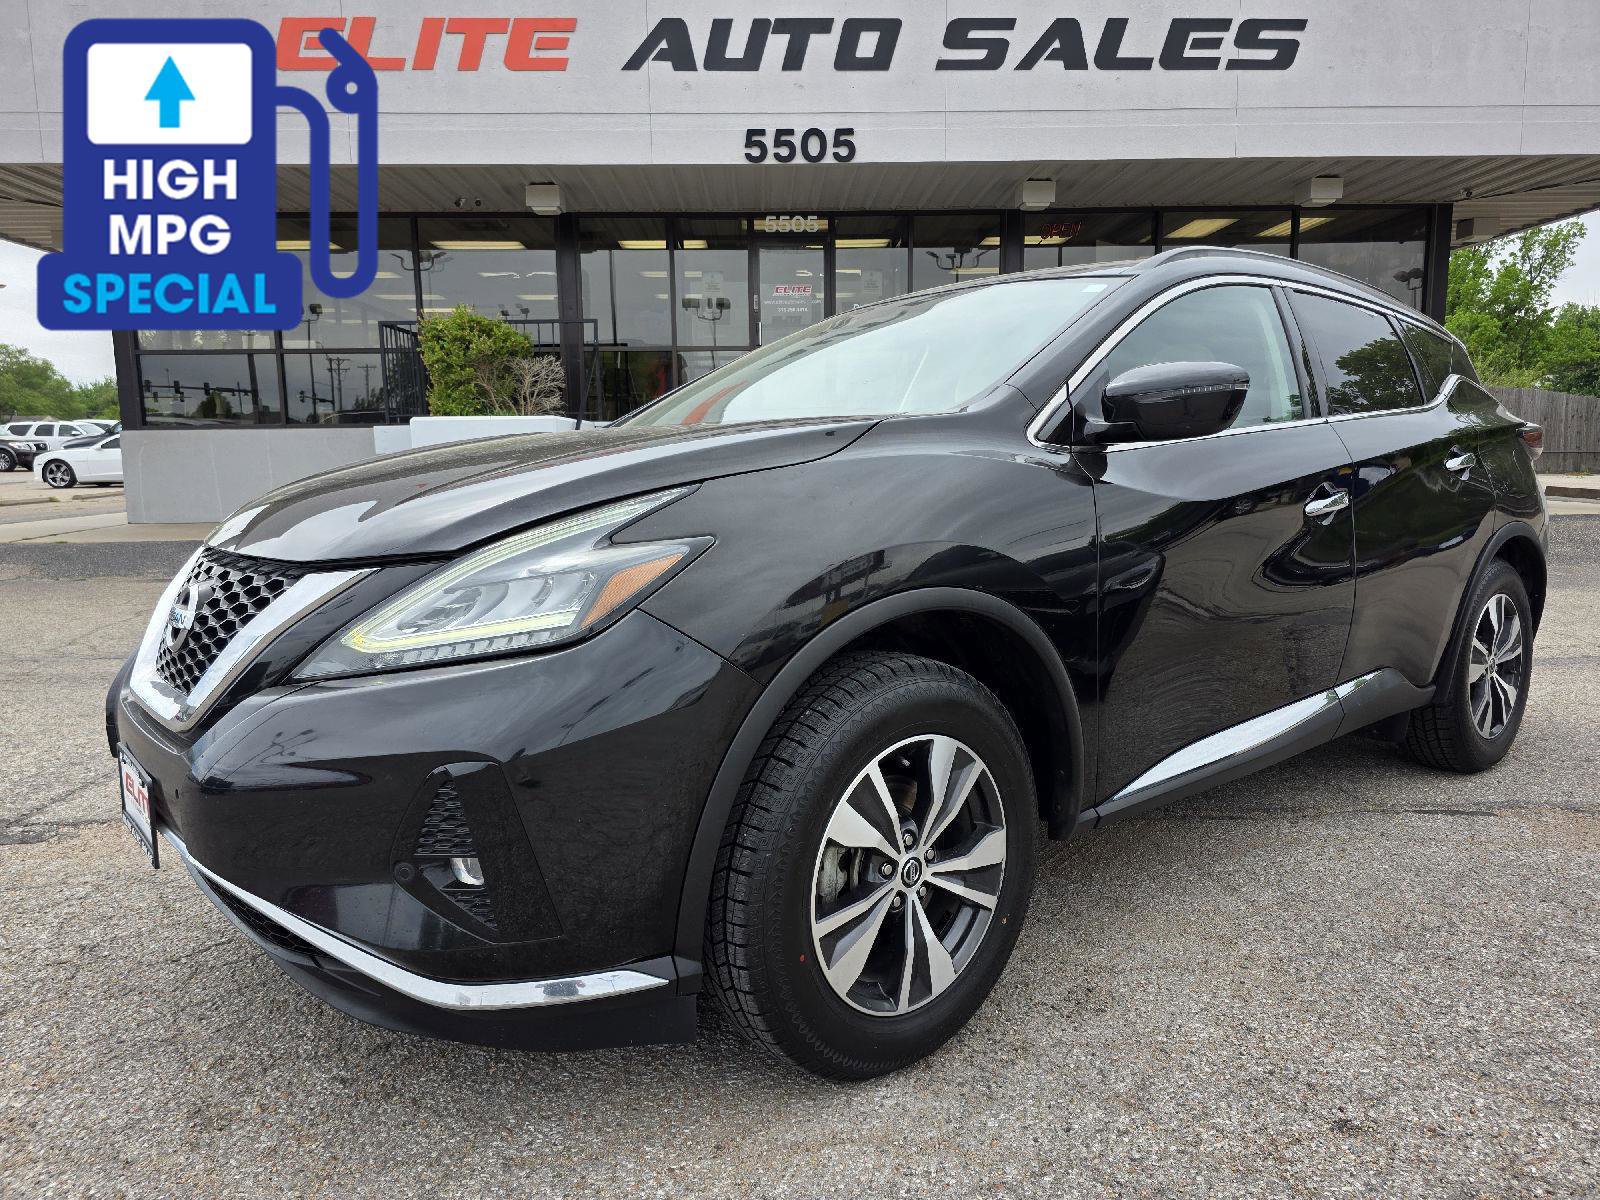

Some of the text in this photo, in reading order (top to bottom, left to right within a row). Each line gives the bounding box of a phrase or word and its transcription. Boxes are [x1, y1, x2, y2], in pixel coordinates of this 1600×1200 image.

[276, 17, 1308, 71] ELITE AUTO SALES
[744, 127, 856, 163] 5505
[765, 215, 819, 233] 5505
[1040, 222, 1082, 240] OPEN
[774, 285, 812, 294] ELITE
[125, 771, 151, 816] ELIT
